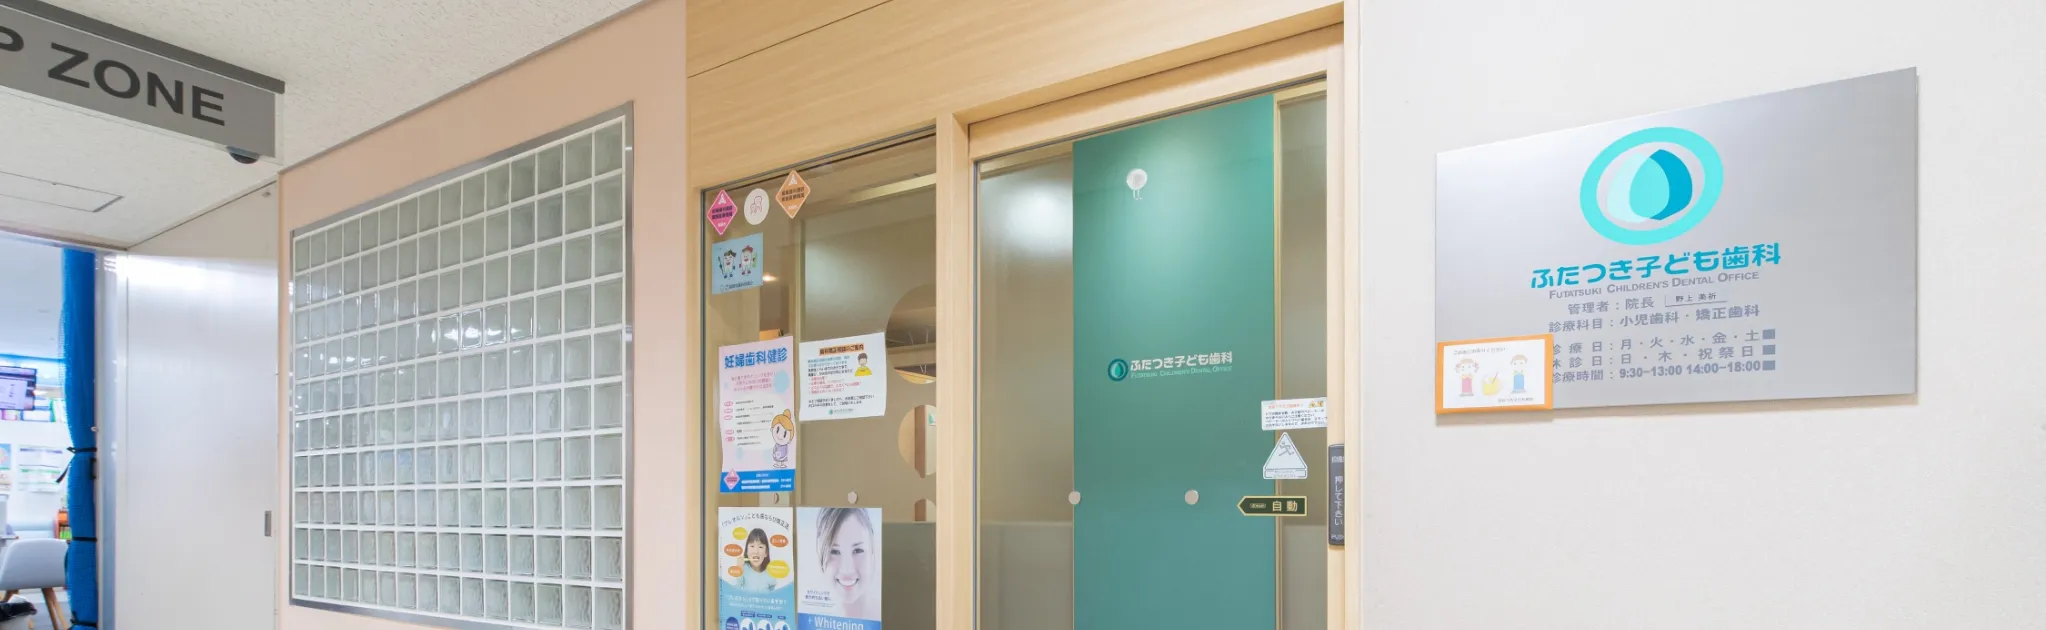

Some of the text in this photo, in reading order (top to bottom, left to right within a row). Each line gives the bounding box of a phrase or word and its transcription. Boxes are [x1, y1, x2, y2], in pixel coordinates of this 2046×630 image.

[48, 42, 225, 126] ZONE
[1531, 243, 1781, 289] ふたつき子ども歯科
[1549, 272, 1760, 299] FUTATSUKI CHILDREN'S DENTAL OFFICE
[724, 347, 788, 369] 妊婦歯科健診
[1130, 351, 1233, 371] ふたつき子ども歯科
[1272, 500, 1298, 512] 自動
[1334, 475, 1344, 525] 押して下さい
